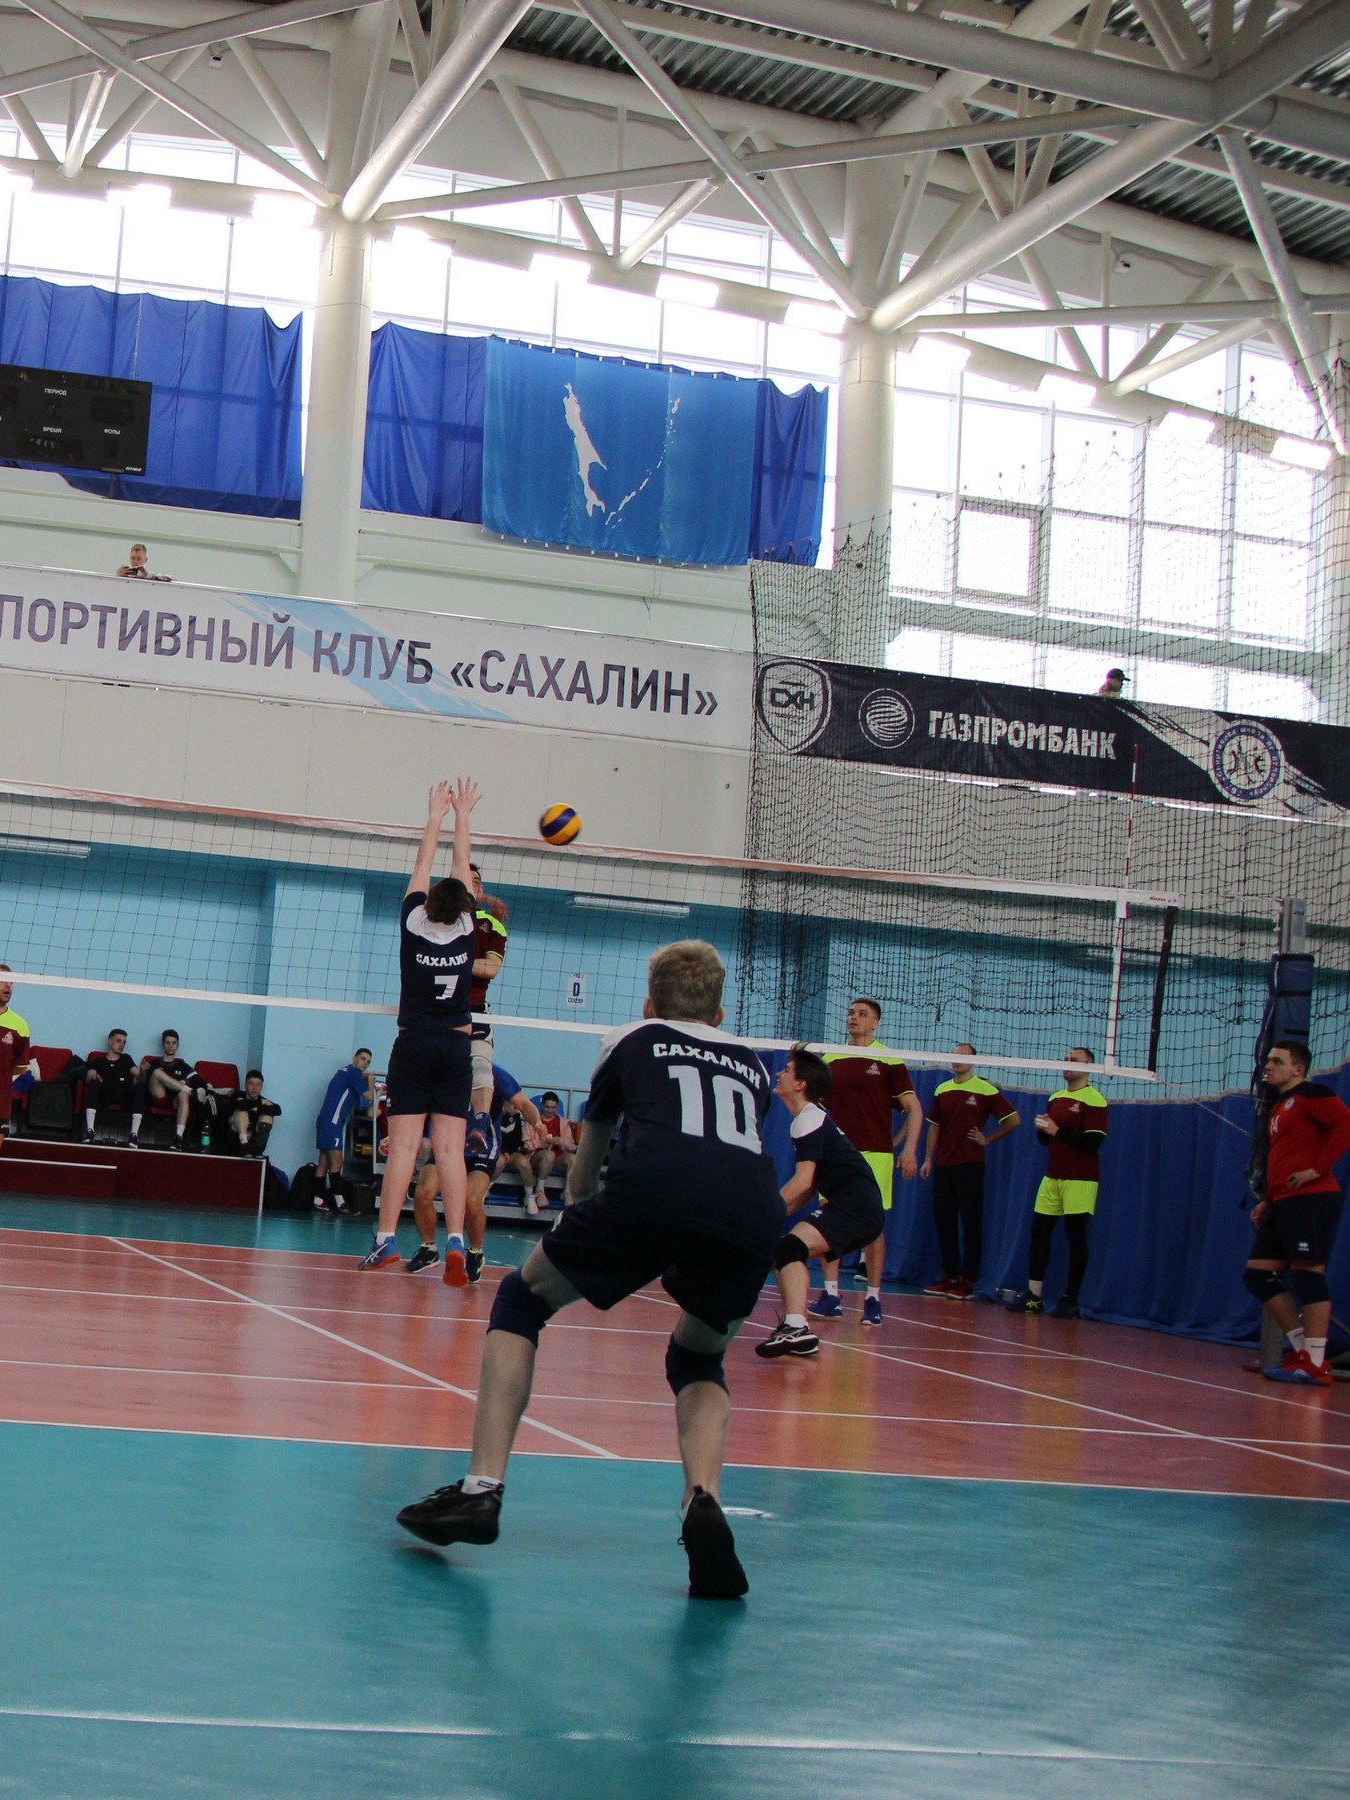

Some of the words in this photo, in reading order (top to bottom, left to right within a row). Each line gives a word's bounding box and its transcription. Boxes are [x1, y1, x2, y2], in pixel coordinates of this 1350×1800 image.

[44, 388, 67, 397] ПЕРИОД
[42, 426, 62, 434] ВРЕМЯ
[311, 629, 434, 685] КЛУБ
[450, 650, 719, 717] «САХАЛИН»
[928, 709, 1117, 760] ГАЗПРОМБАНК
[416, 952, 468, 966] САХАЛИН
[434, 975, 459, 999] 7
[573, 982, 580, 996] D
[653, 1043, 761, 1090] САХАЛИН
[668, 1065, 761, 1154] 10
